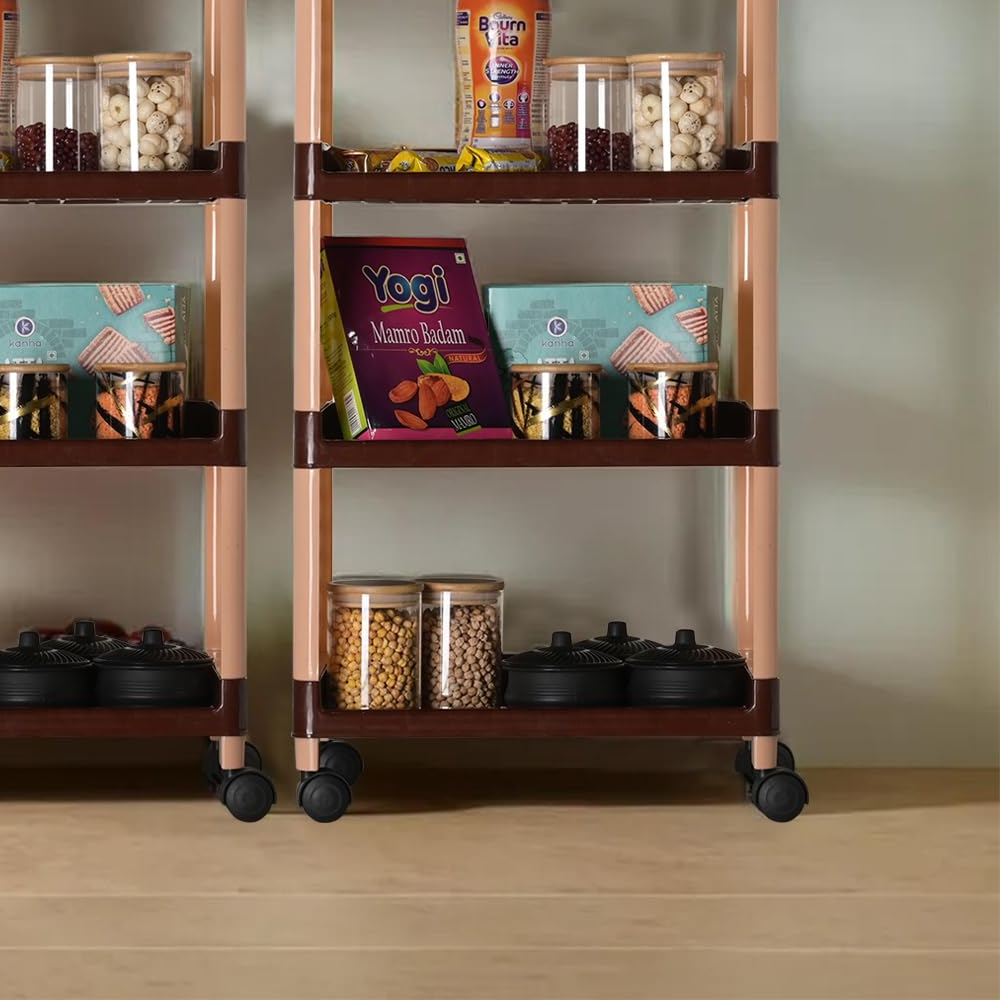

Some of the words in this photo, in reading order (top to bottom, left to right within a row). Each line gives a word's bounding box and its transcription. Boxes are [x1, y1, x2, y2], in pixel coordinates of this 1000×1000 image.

[361, 264, 451, 314] Yogi
[370, 321, 419, 344] Mamro
[419, 320, 466, 345] Badam
